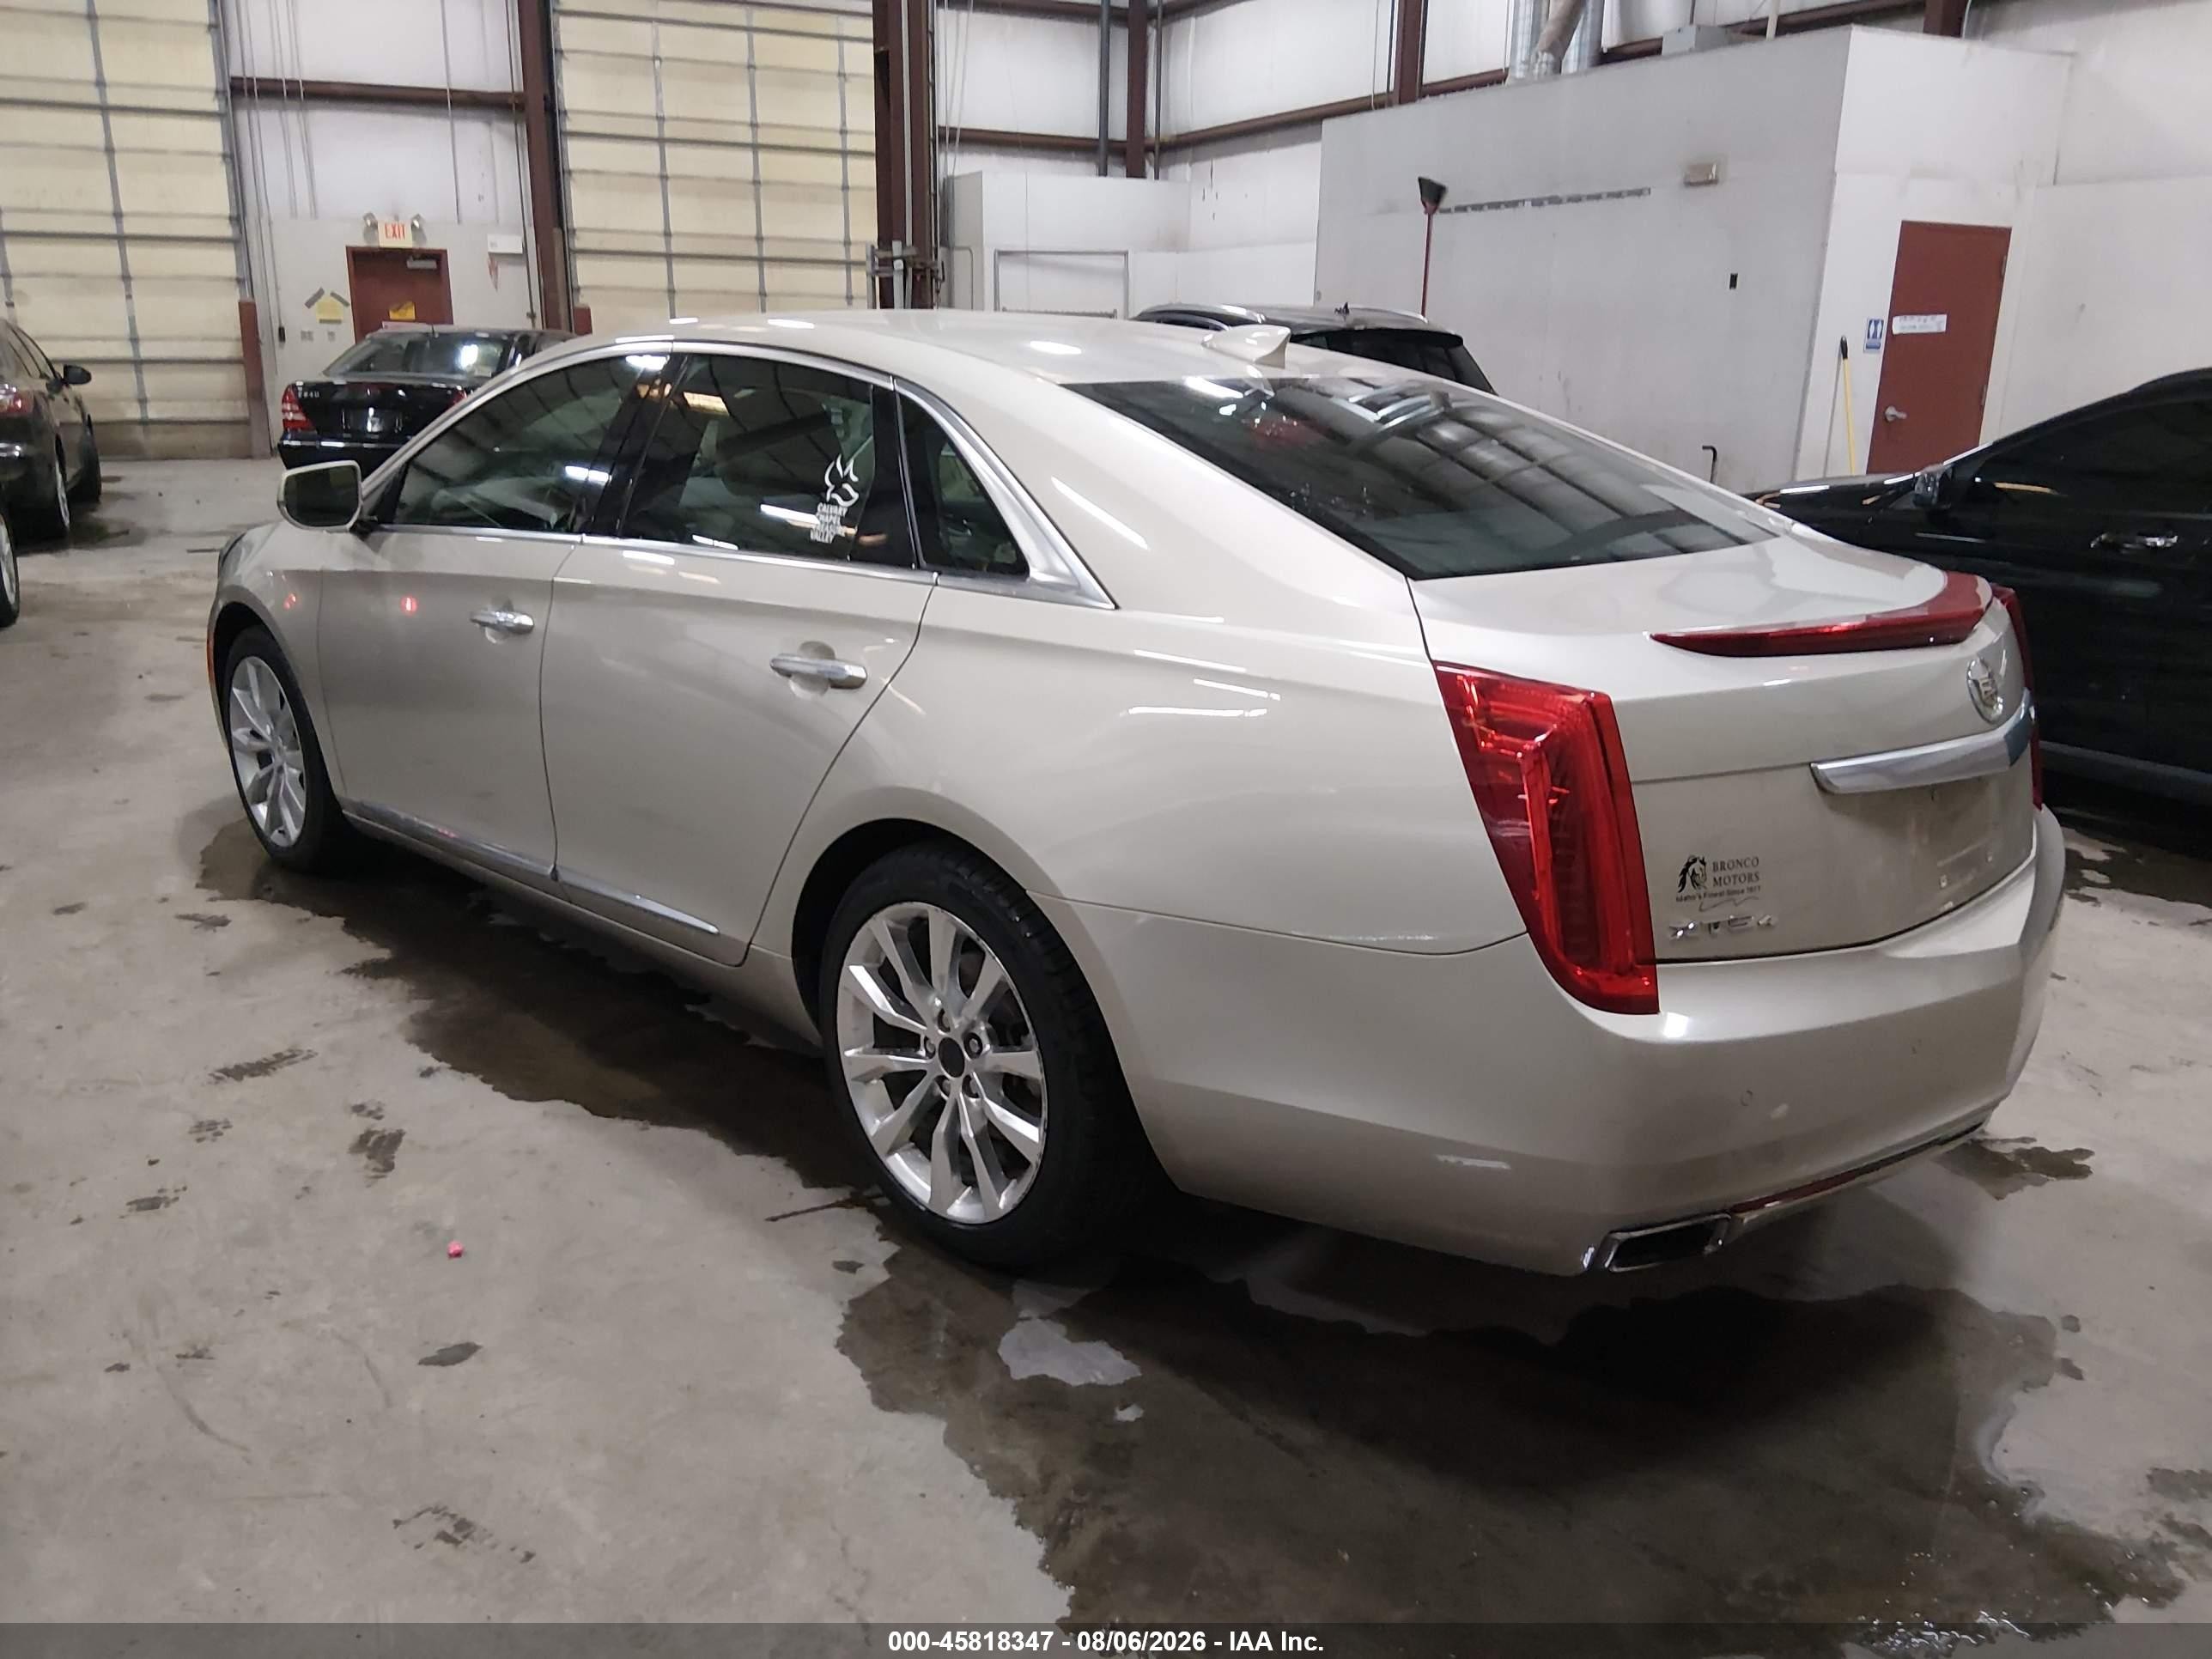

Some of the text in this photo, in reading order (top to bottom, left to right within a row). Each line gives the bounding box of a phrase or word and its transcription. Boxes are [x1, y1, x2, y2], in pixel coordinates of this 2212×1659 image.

[385, 222, 406, 240] EXIT
[1712, 856, 1759, 872] BRONCO
[1712, 872, 1759, 887] MOTORS
